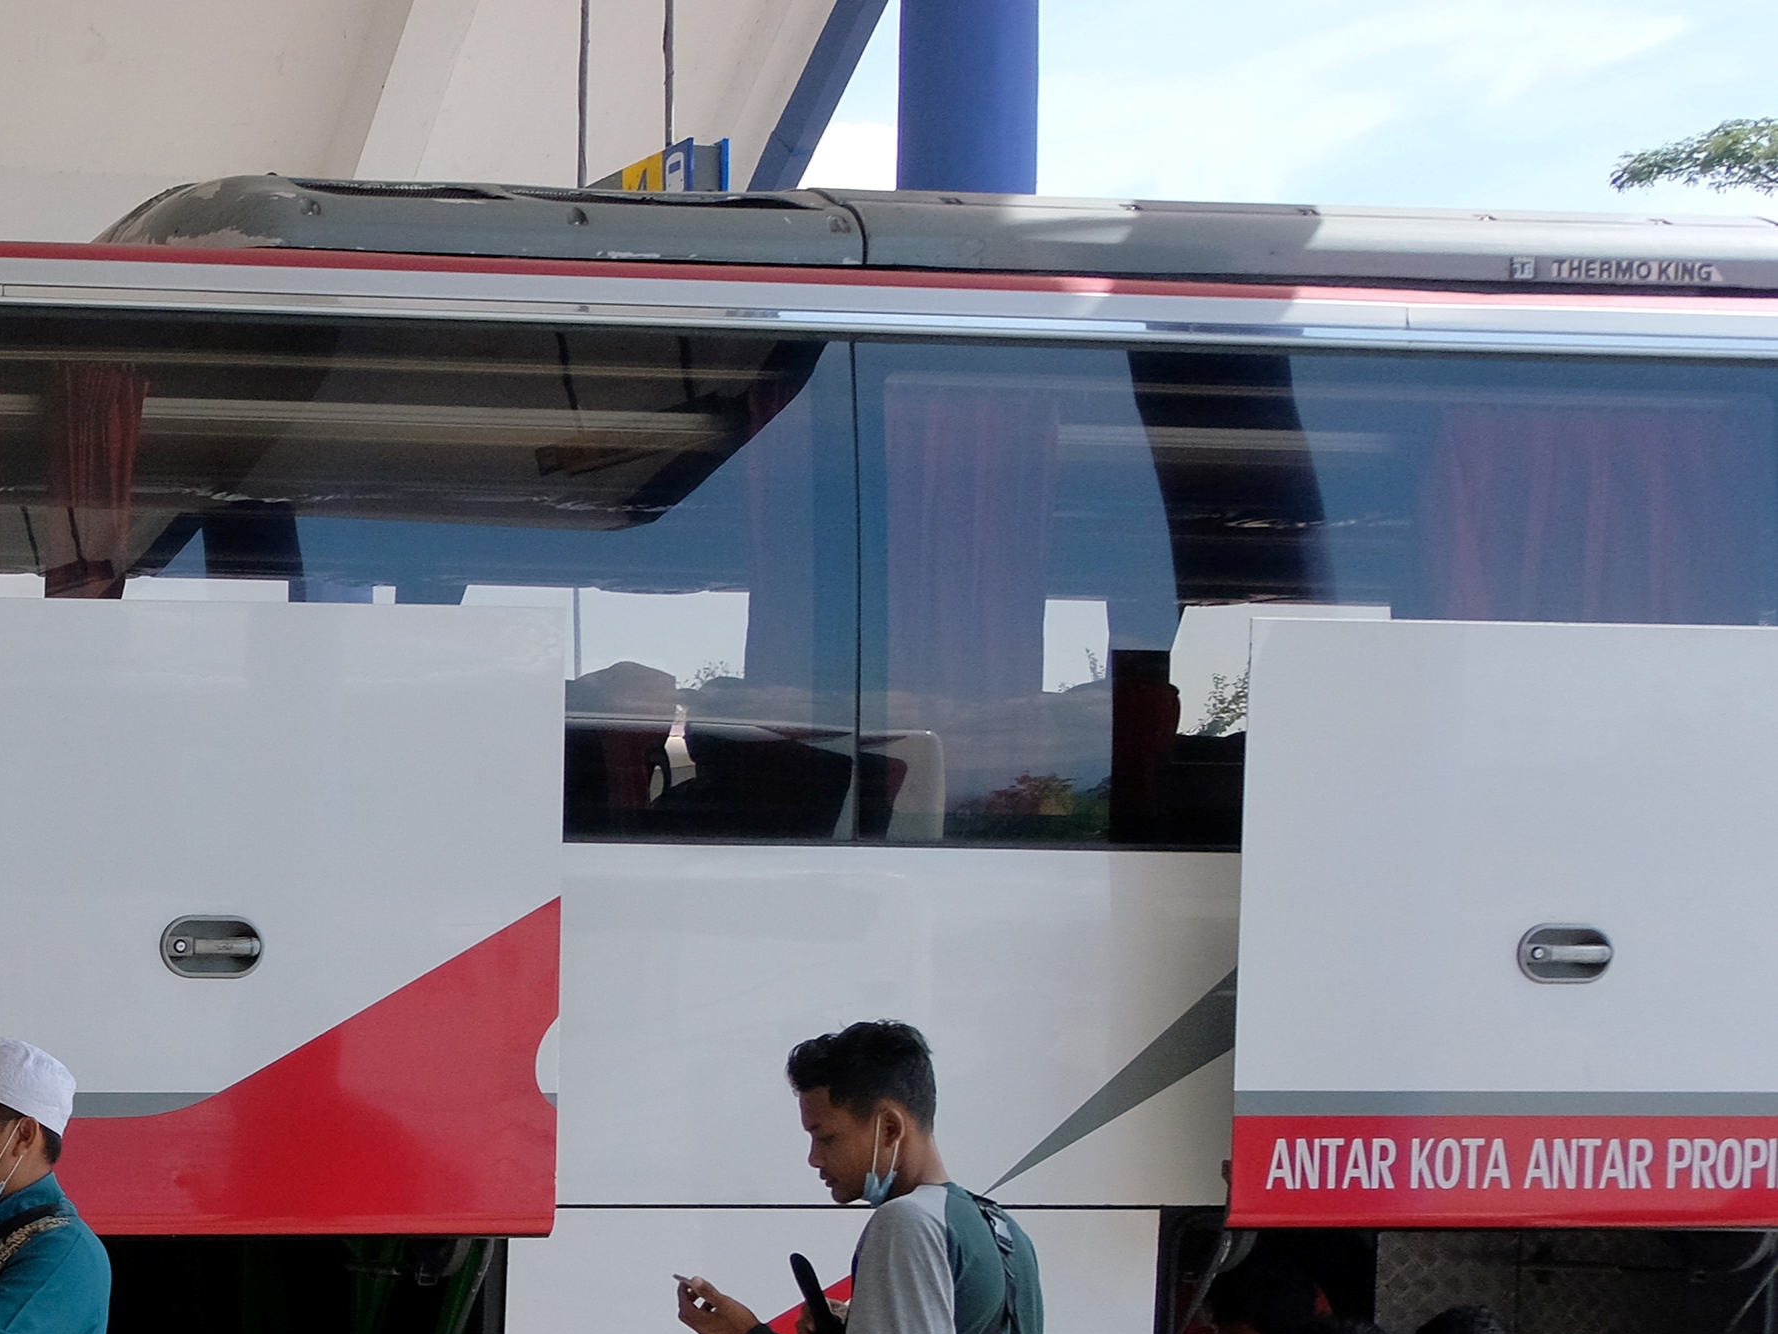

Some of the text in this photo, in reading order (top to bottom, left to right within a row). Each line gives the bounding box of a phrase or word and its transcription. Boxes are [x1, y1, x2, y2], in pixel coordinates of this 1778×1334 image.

[1552, 259, 1714, 281] THERMO KING
[1266, 1137, 1397, 1190] ANTAR
[1409, 1137, 1511, 1190] KOTA
[1523, 1137, 1654, 1190] ANTAR
